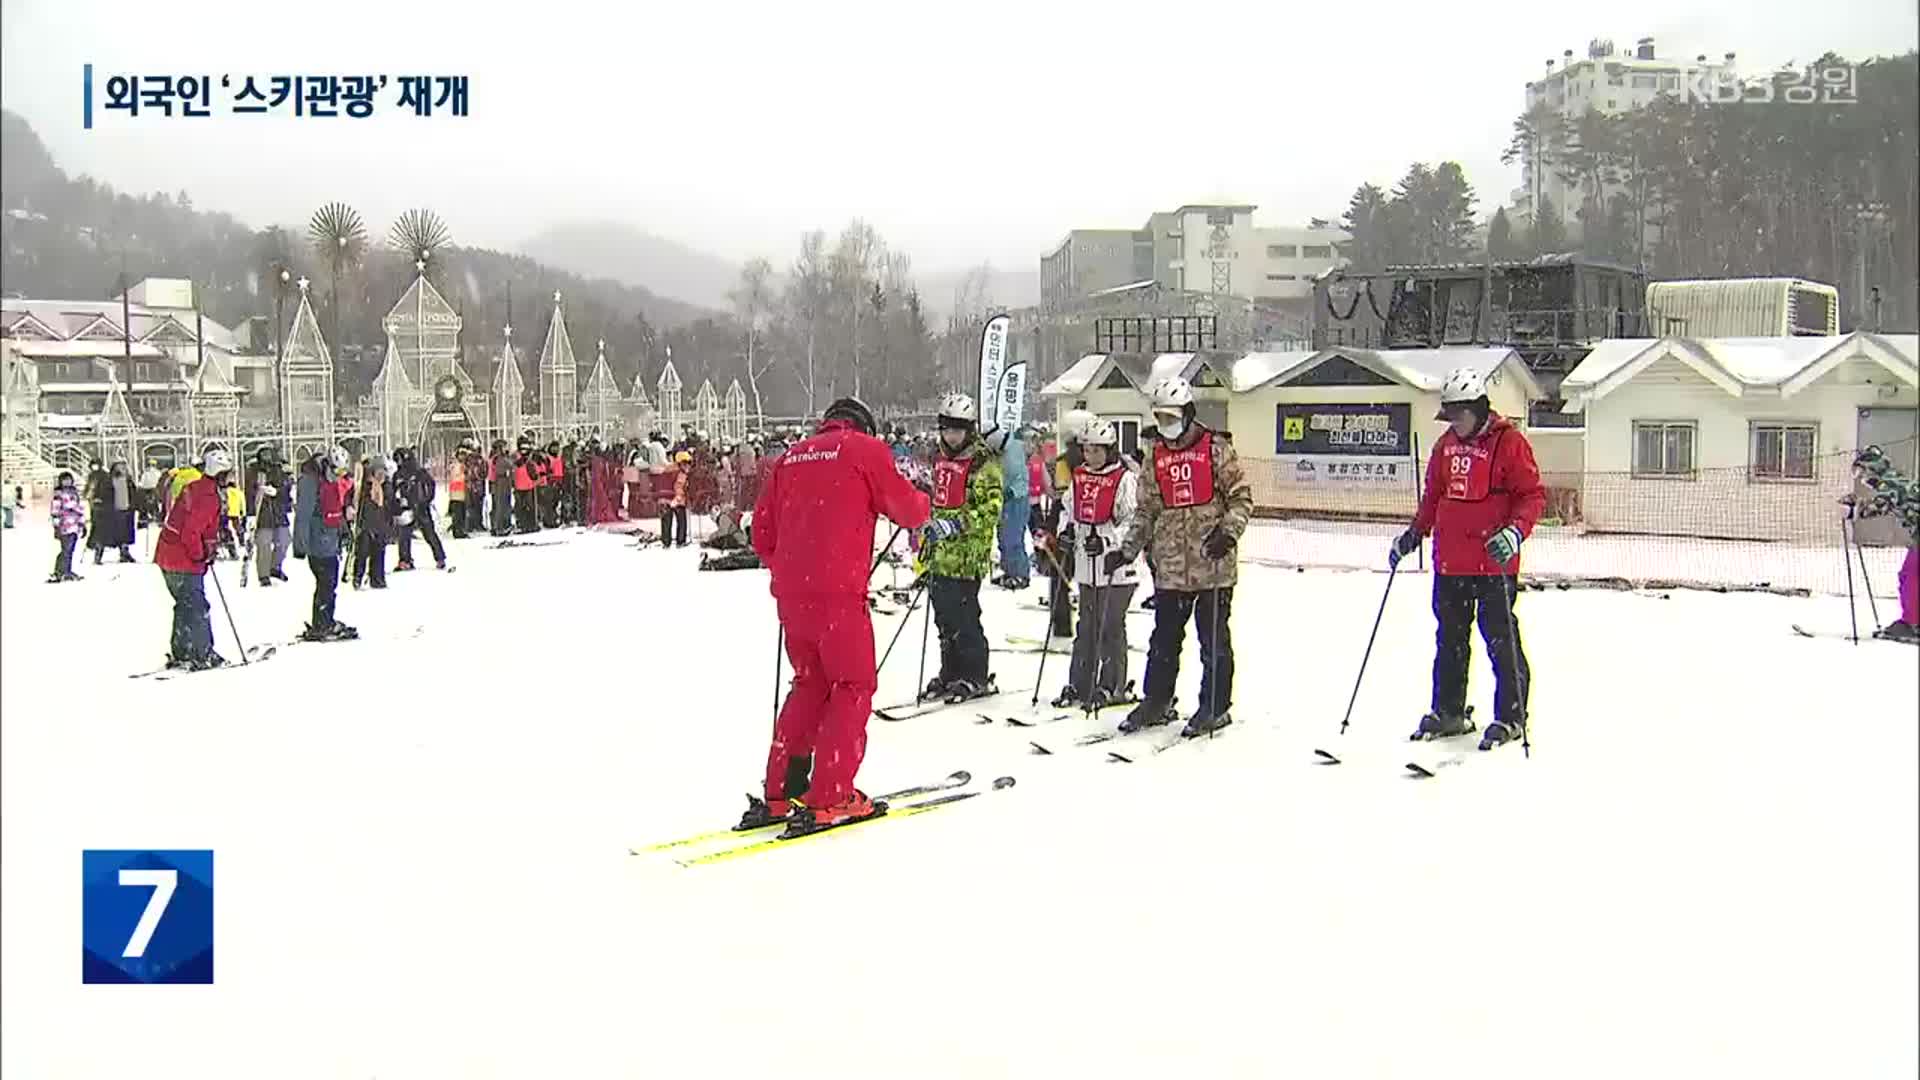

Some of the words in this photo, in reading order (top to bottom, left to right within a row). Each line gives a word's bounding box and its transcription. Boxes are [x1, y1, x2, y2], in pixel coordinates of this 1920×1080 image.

[1170, 463, 1192, 482] 90
[1451, 455, 1471, 475] 89
[1082, 483, 1099, 499] 54
